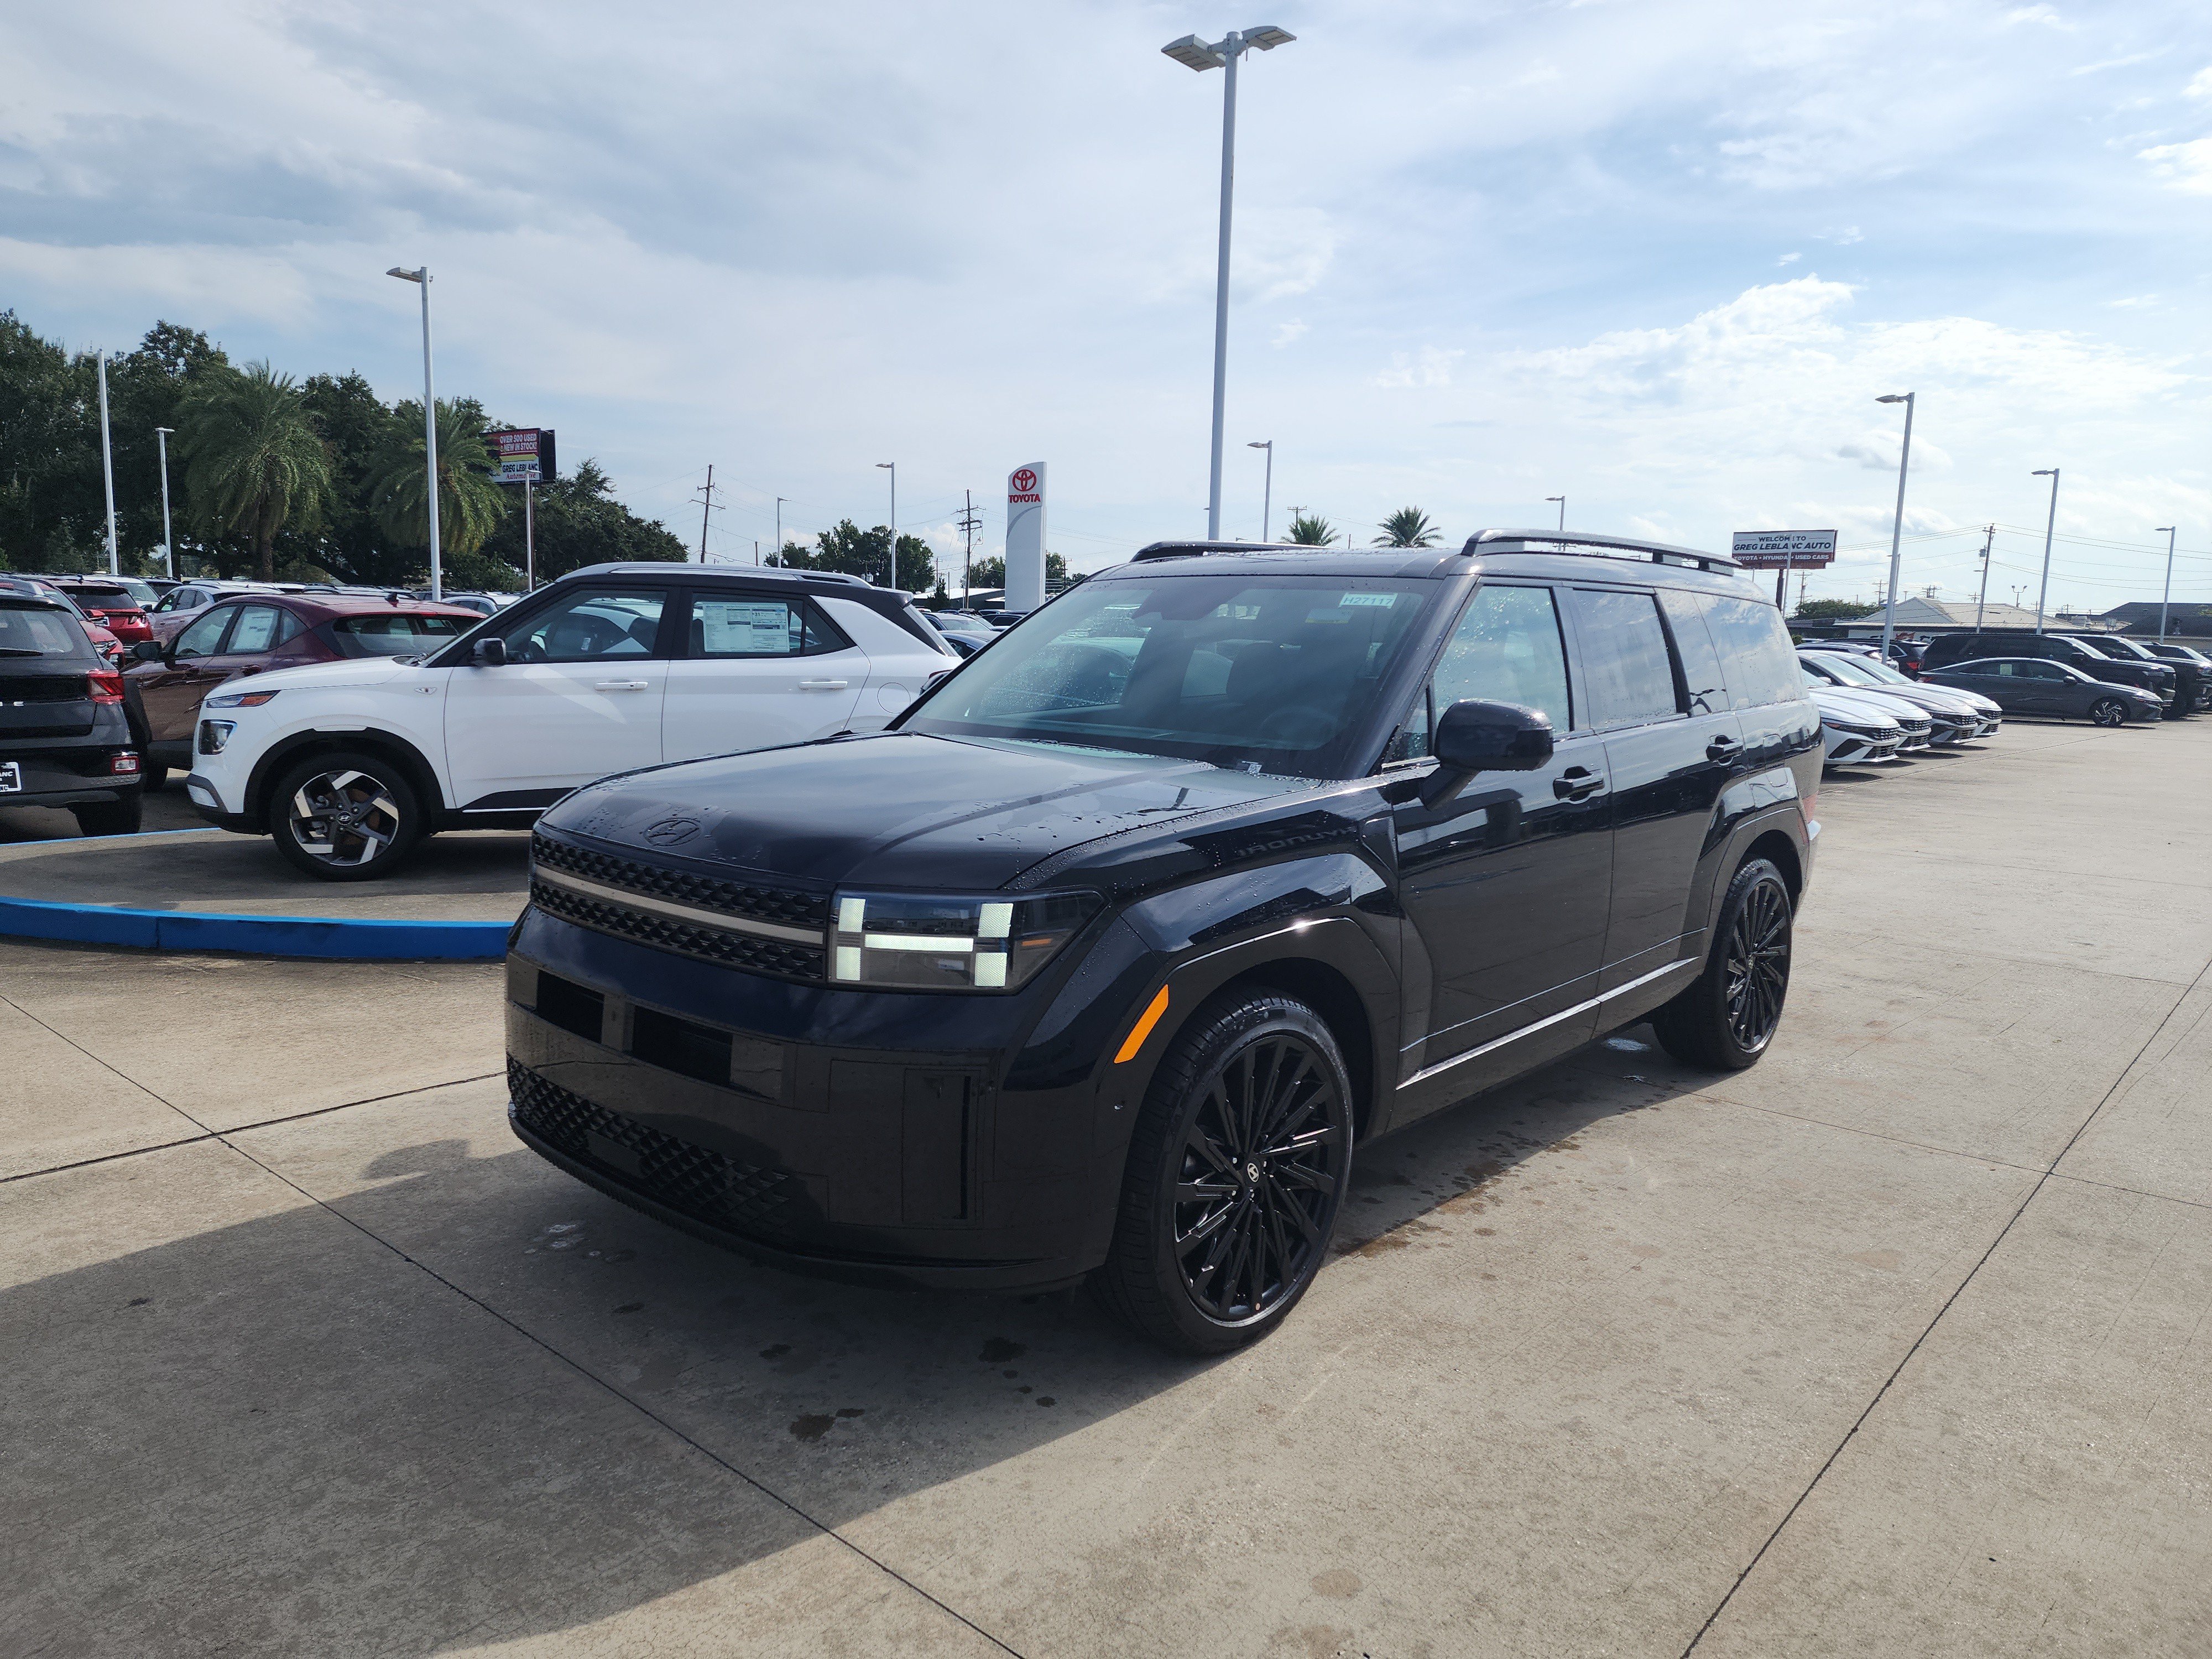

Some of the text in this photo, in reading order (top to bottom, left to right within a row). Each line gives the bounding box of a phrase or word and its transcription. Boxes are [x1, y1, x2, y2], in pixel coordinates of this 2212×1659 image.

[500, 433, 537, 444] OVER 500 USED
[504, 443, 514, 451] NEW
[515, 442, 520, 451] IN
[502, 464, 515, 473] GREG
[1008, 493, 1041, 503] TOYOTA
